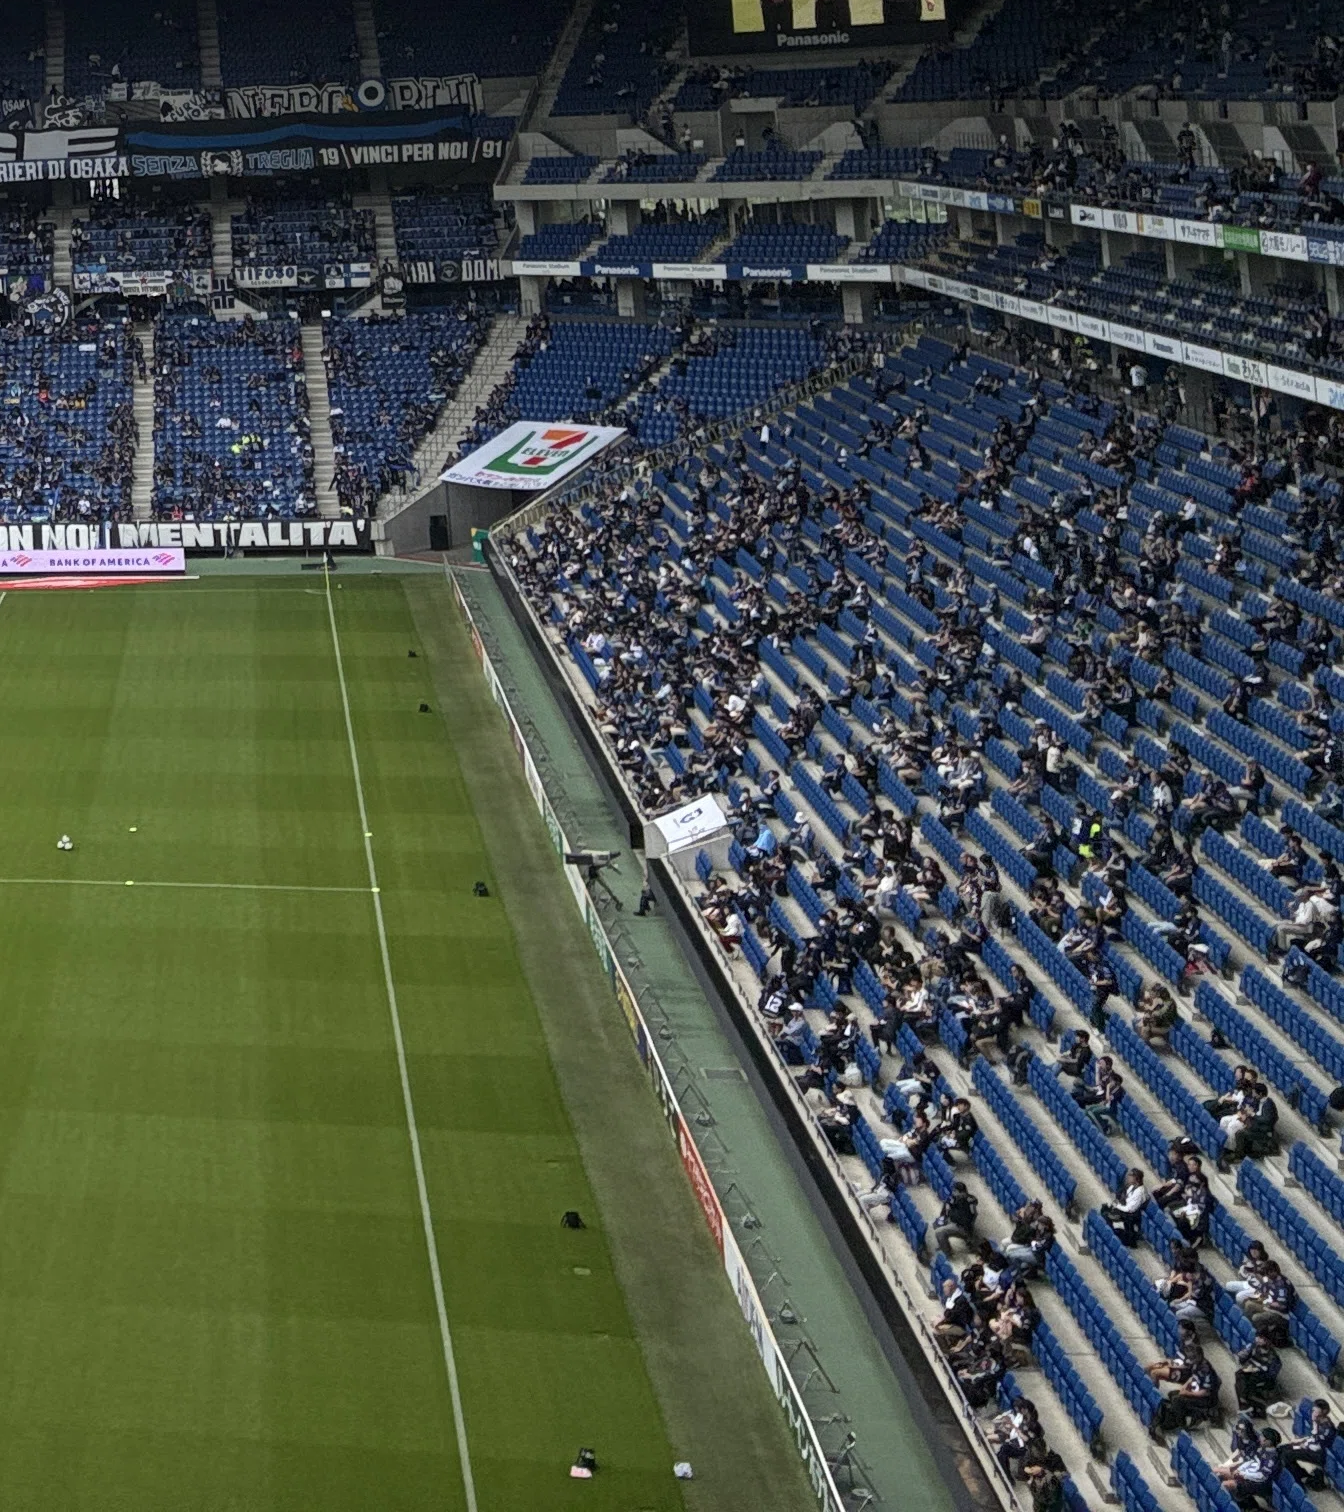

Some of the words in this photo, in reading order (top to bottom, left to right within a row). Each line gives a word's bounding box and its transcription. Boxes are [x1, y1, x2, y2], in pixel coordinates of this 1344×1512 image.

[777, 30, 850, 47] Panasonic
[319, 147, 340, 166] 19
[351, 144, 400, 165] VINCI
[402, 144, 435, 163] PER
[438, 141, 468, 161] NOI
[481, 140, 503, 159] 91
[48, 159, 67, 180] DI
[69, 156, 130, 179] OSAKA
[131, 155, 198, 177] SENZA
[238, 267, 295, 282] TIFOSO
[594, 264, 640, 277] Panasonic
[742, 265, 792, 279] Panasonic
[50, 557, 80, 567] BANK
[82, 557, 98, 567] OF
[99, 556, 151, 567] AMERICA
[765, 994, 783, 1013] 12
